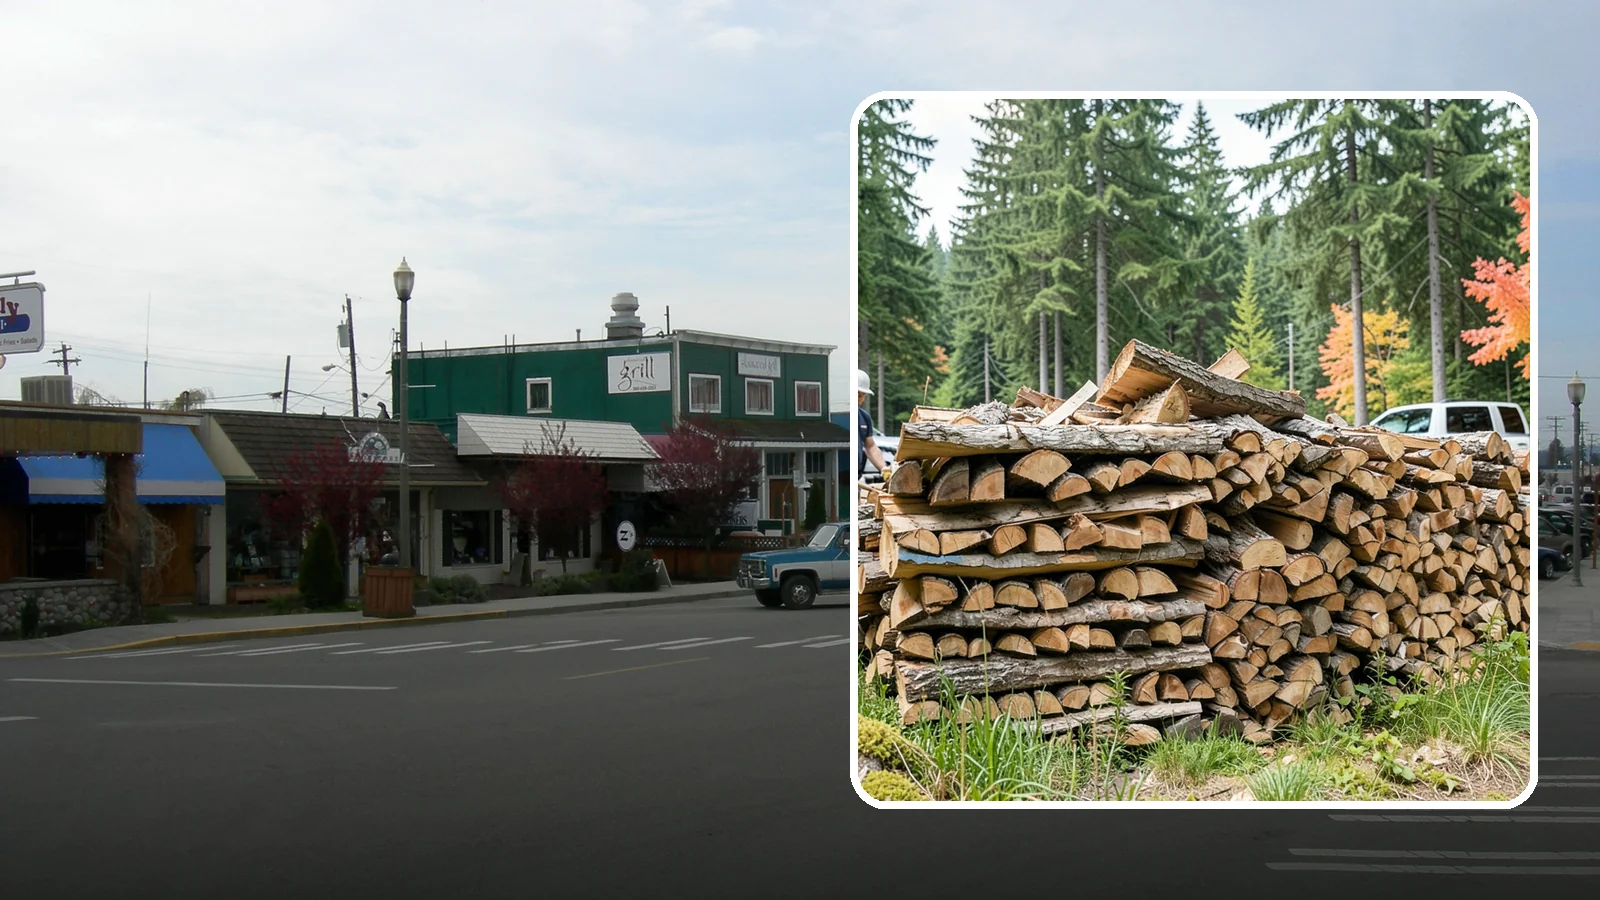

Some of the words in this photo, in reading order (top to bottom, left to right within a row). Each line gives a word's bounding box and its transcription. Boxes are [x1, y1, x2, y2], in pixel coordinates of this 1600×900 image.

[3, 338, 16, 346] Fries
[20, 337, 38, 345] Salads
[618, 355, 655, 392] grill
